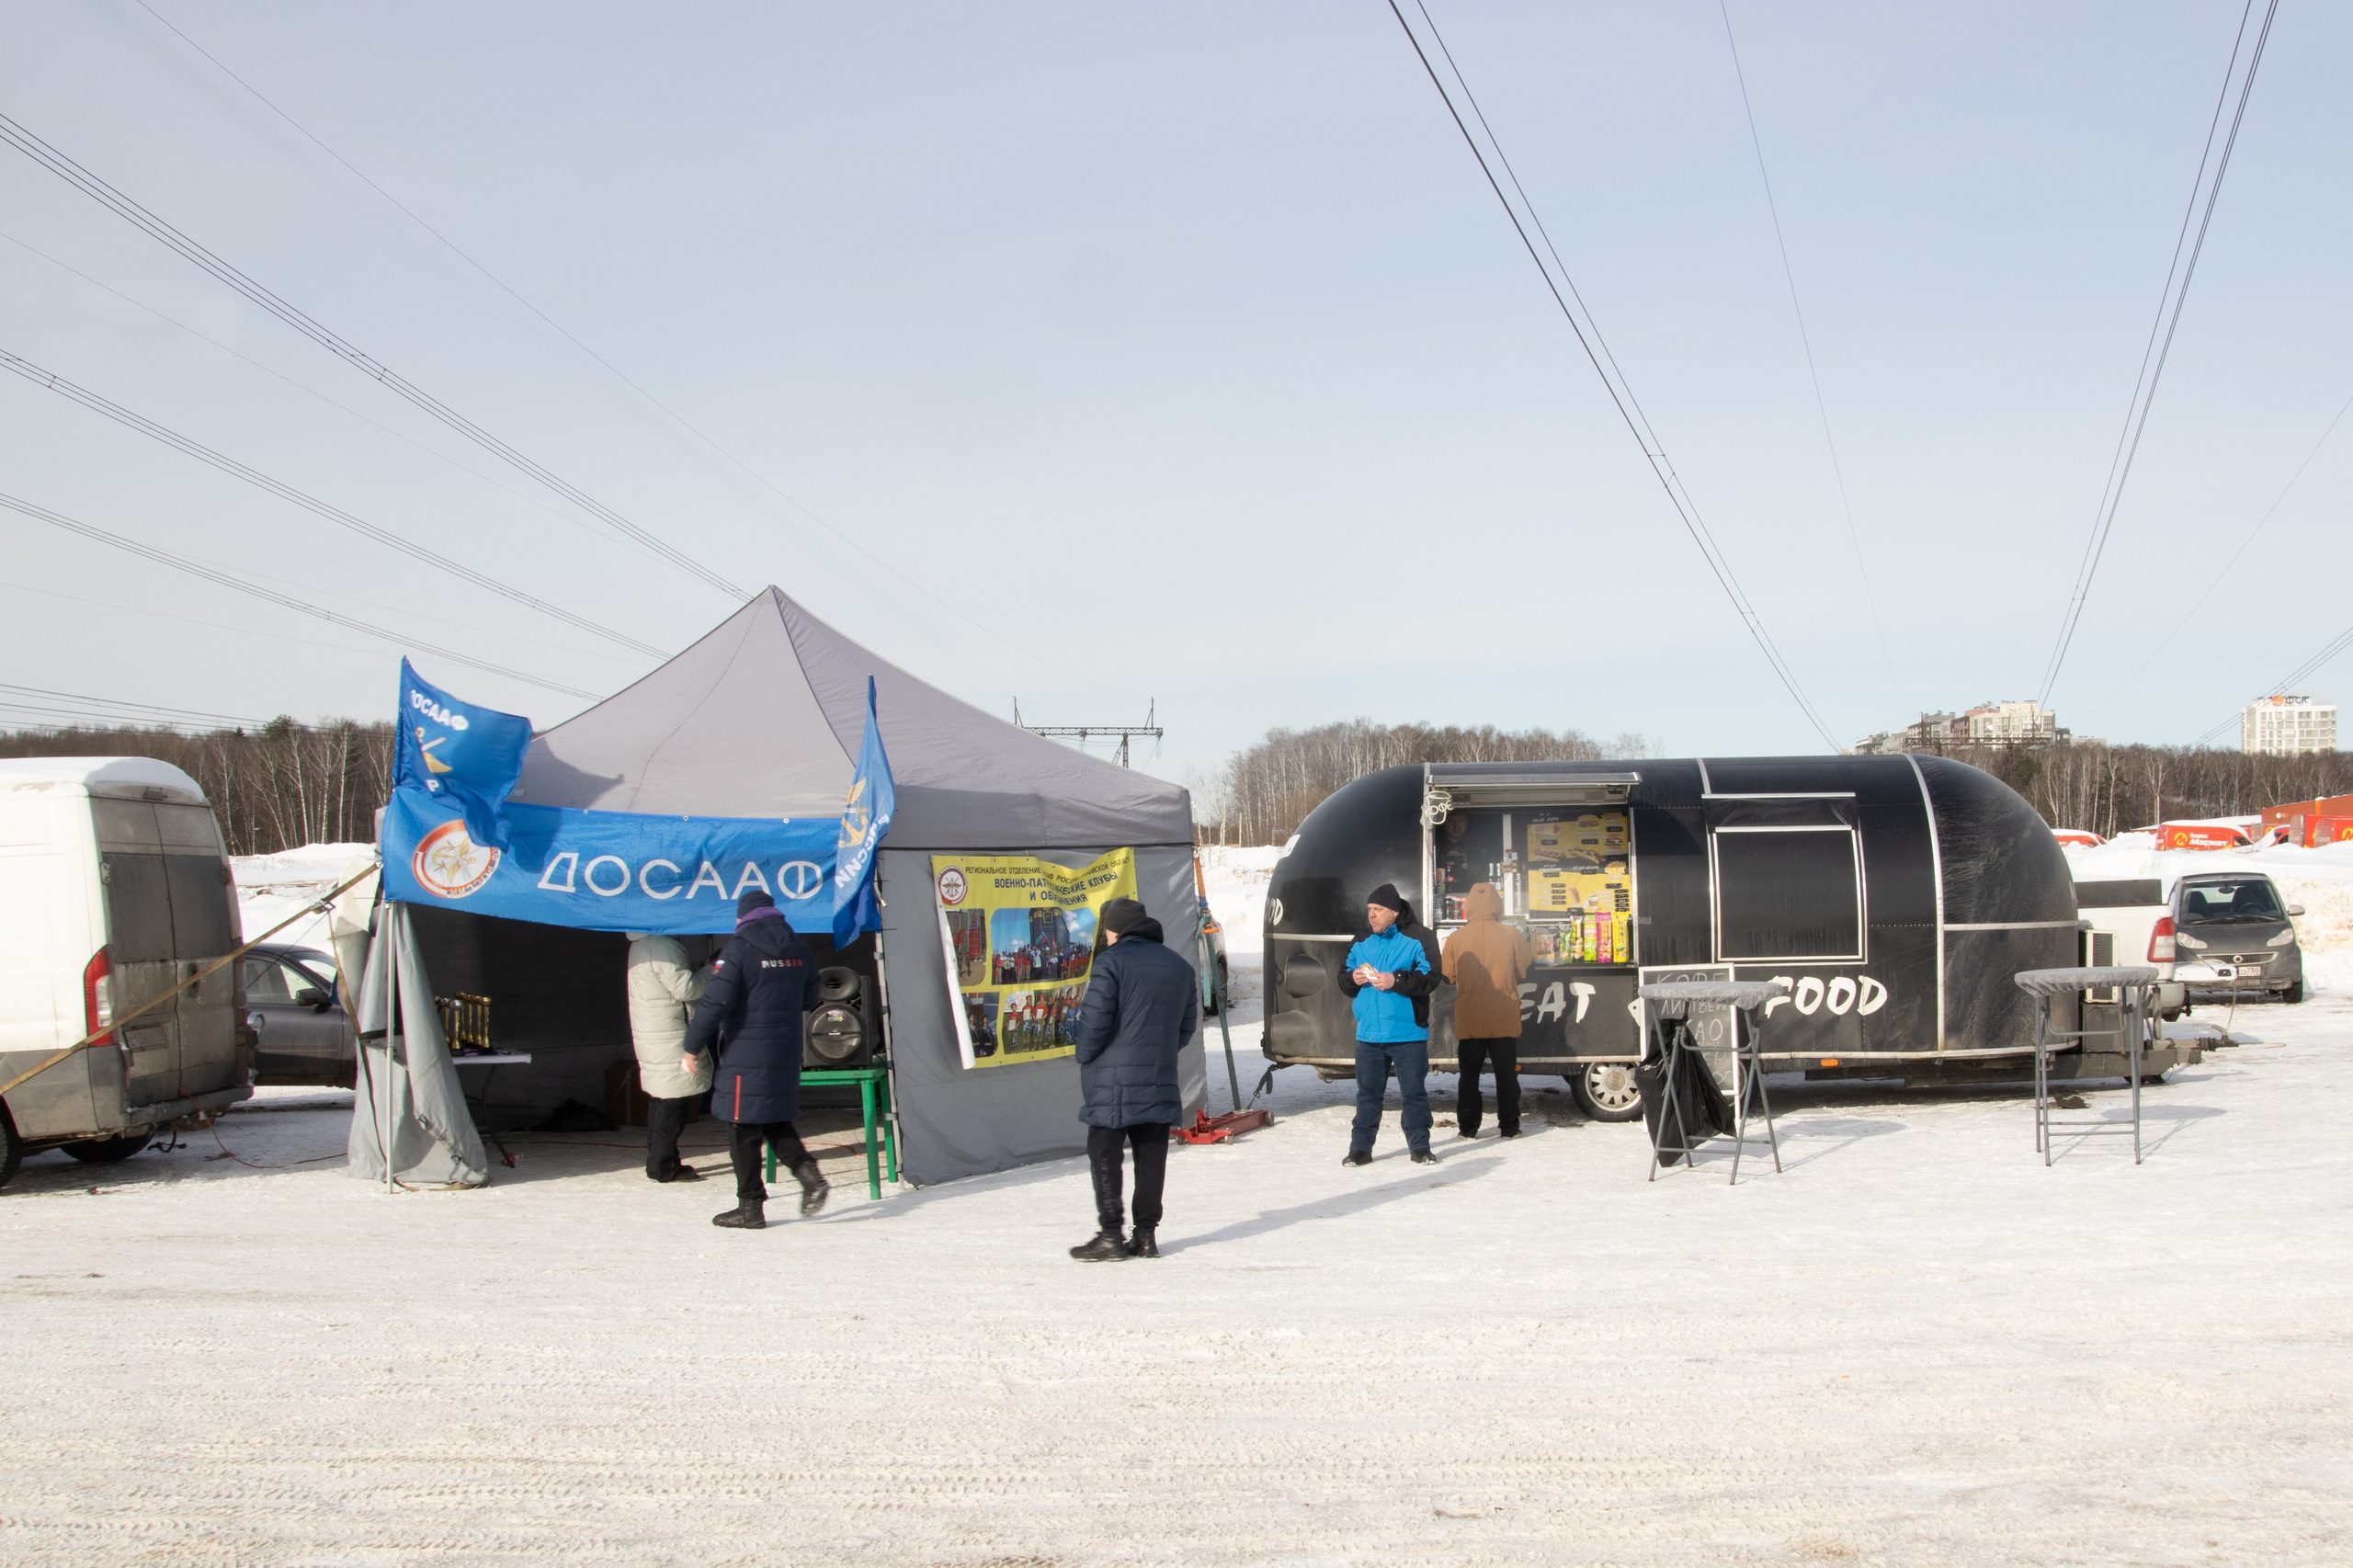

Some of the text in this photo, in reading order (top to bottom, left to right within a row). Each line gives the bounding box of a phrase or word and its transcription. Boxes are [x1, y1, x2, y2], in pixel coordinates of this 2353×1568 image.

[2188, 838, 2228, 847] Маркет
[965, 866, 1007, 874] РЕГИОНАЛЬНОЕ
[1008, 867, 1042, 875] ОТДЕЛЕНИЕ
[537, 851, 824, 901] ДОСААФ
[1088, 871, 1119, 888] КЛУБЫ
[1029, 891, 1036, 901] И
[761, 960, 803, 969] RUSSIA
[1517, 975, 1888, 1024] EAT FOOD
